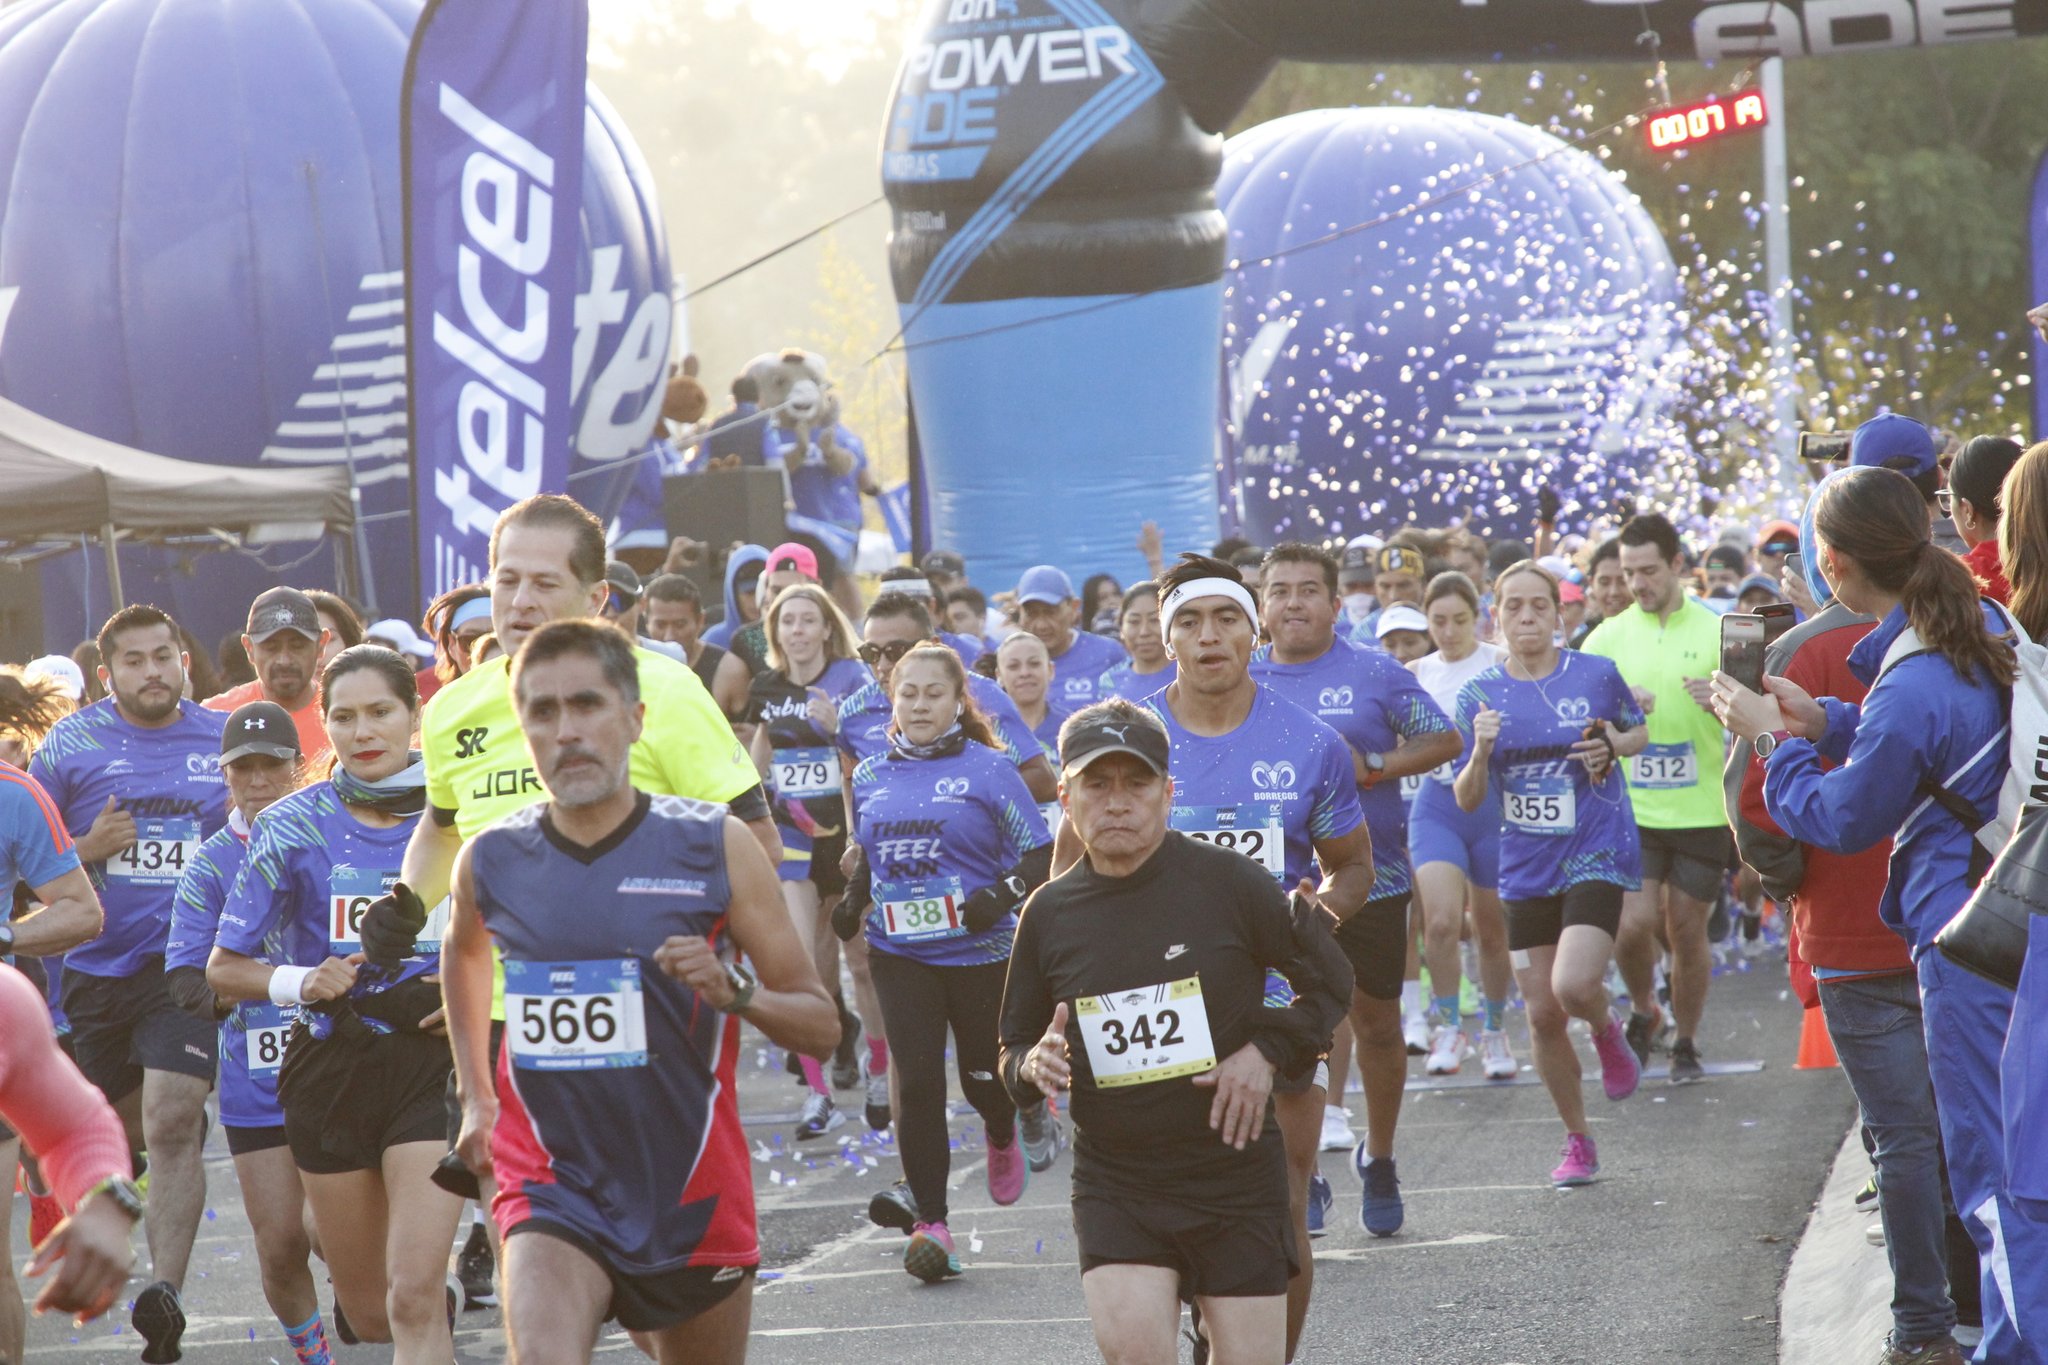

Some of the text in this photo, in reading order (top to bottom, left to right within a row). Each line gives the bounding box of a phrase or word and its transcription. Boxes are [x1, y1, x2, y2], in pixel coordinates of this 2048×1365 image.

[901, 25, 1137, 94] POWER
[434, 82, 554, 540] telcel
[455, 727, 488, 758] SR
[783, 763, 827, 786] 279
[1640, 757, 1686, 778] 512
[1254, 792, 1298, 800] BORREGOS
[1511, 796, 1560, 821] 355
[872, 819, 948, 838] THINK
[120, 841, 184, 870] 434
[876, 838, 944, 865] FEEL
[1191, 830, 1264, 865] 82
[888, 861, 938, 879] RUN
[904, 901, 942, 927] 38
[522, 996, 616, 1045] 566
[1101, 1009, 1185, 1056] 342
